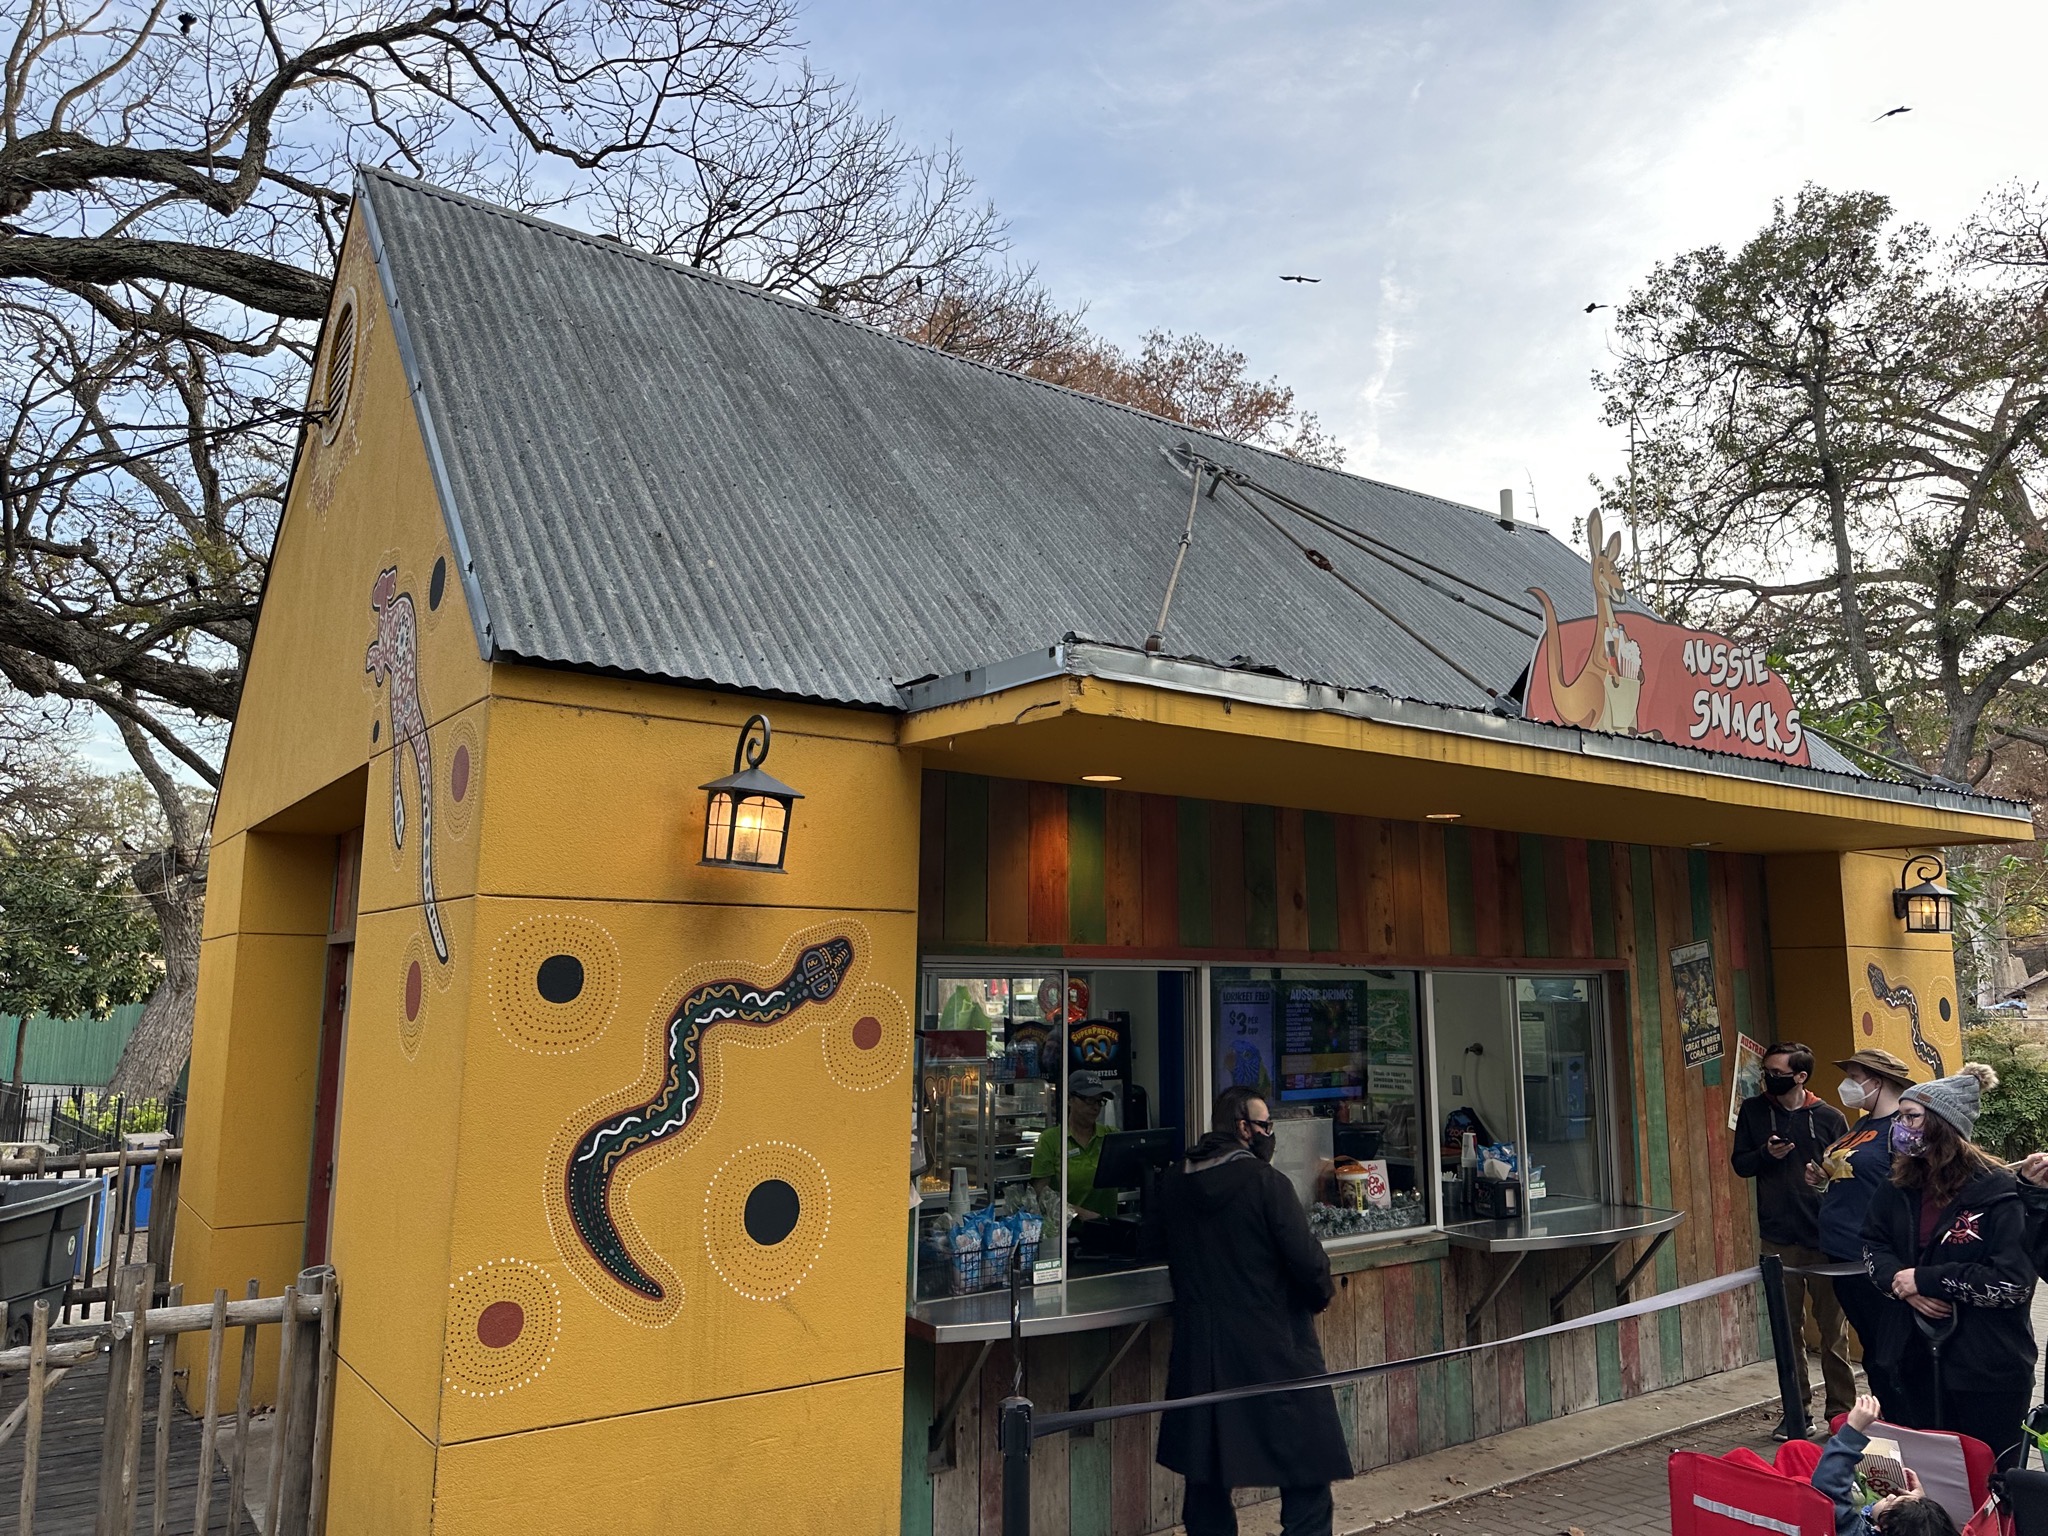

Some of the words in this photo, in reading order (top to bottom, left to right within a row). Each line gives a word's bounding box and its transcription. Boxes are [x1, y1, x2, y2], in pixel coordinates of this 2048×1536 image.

[1255, 991, 1270, 1001] FEED
[1289, 988, 1321, 1001] AUSSIE
[1322, 988, 1354, 1000] DRINKS
[1248, 1016, 1259, 1025] PER
[1685, 1040, 1700, 1053] GREAT
[1700, 1033, 1721, 1047] BARRIER
[1690, 1048, 1706, 1060] CORAL
[1866, 1478, 1891, 1490] POP
